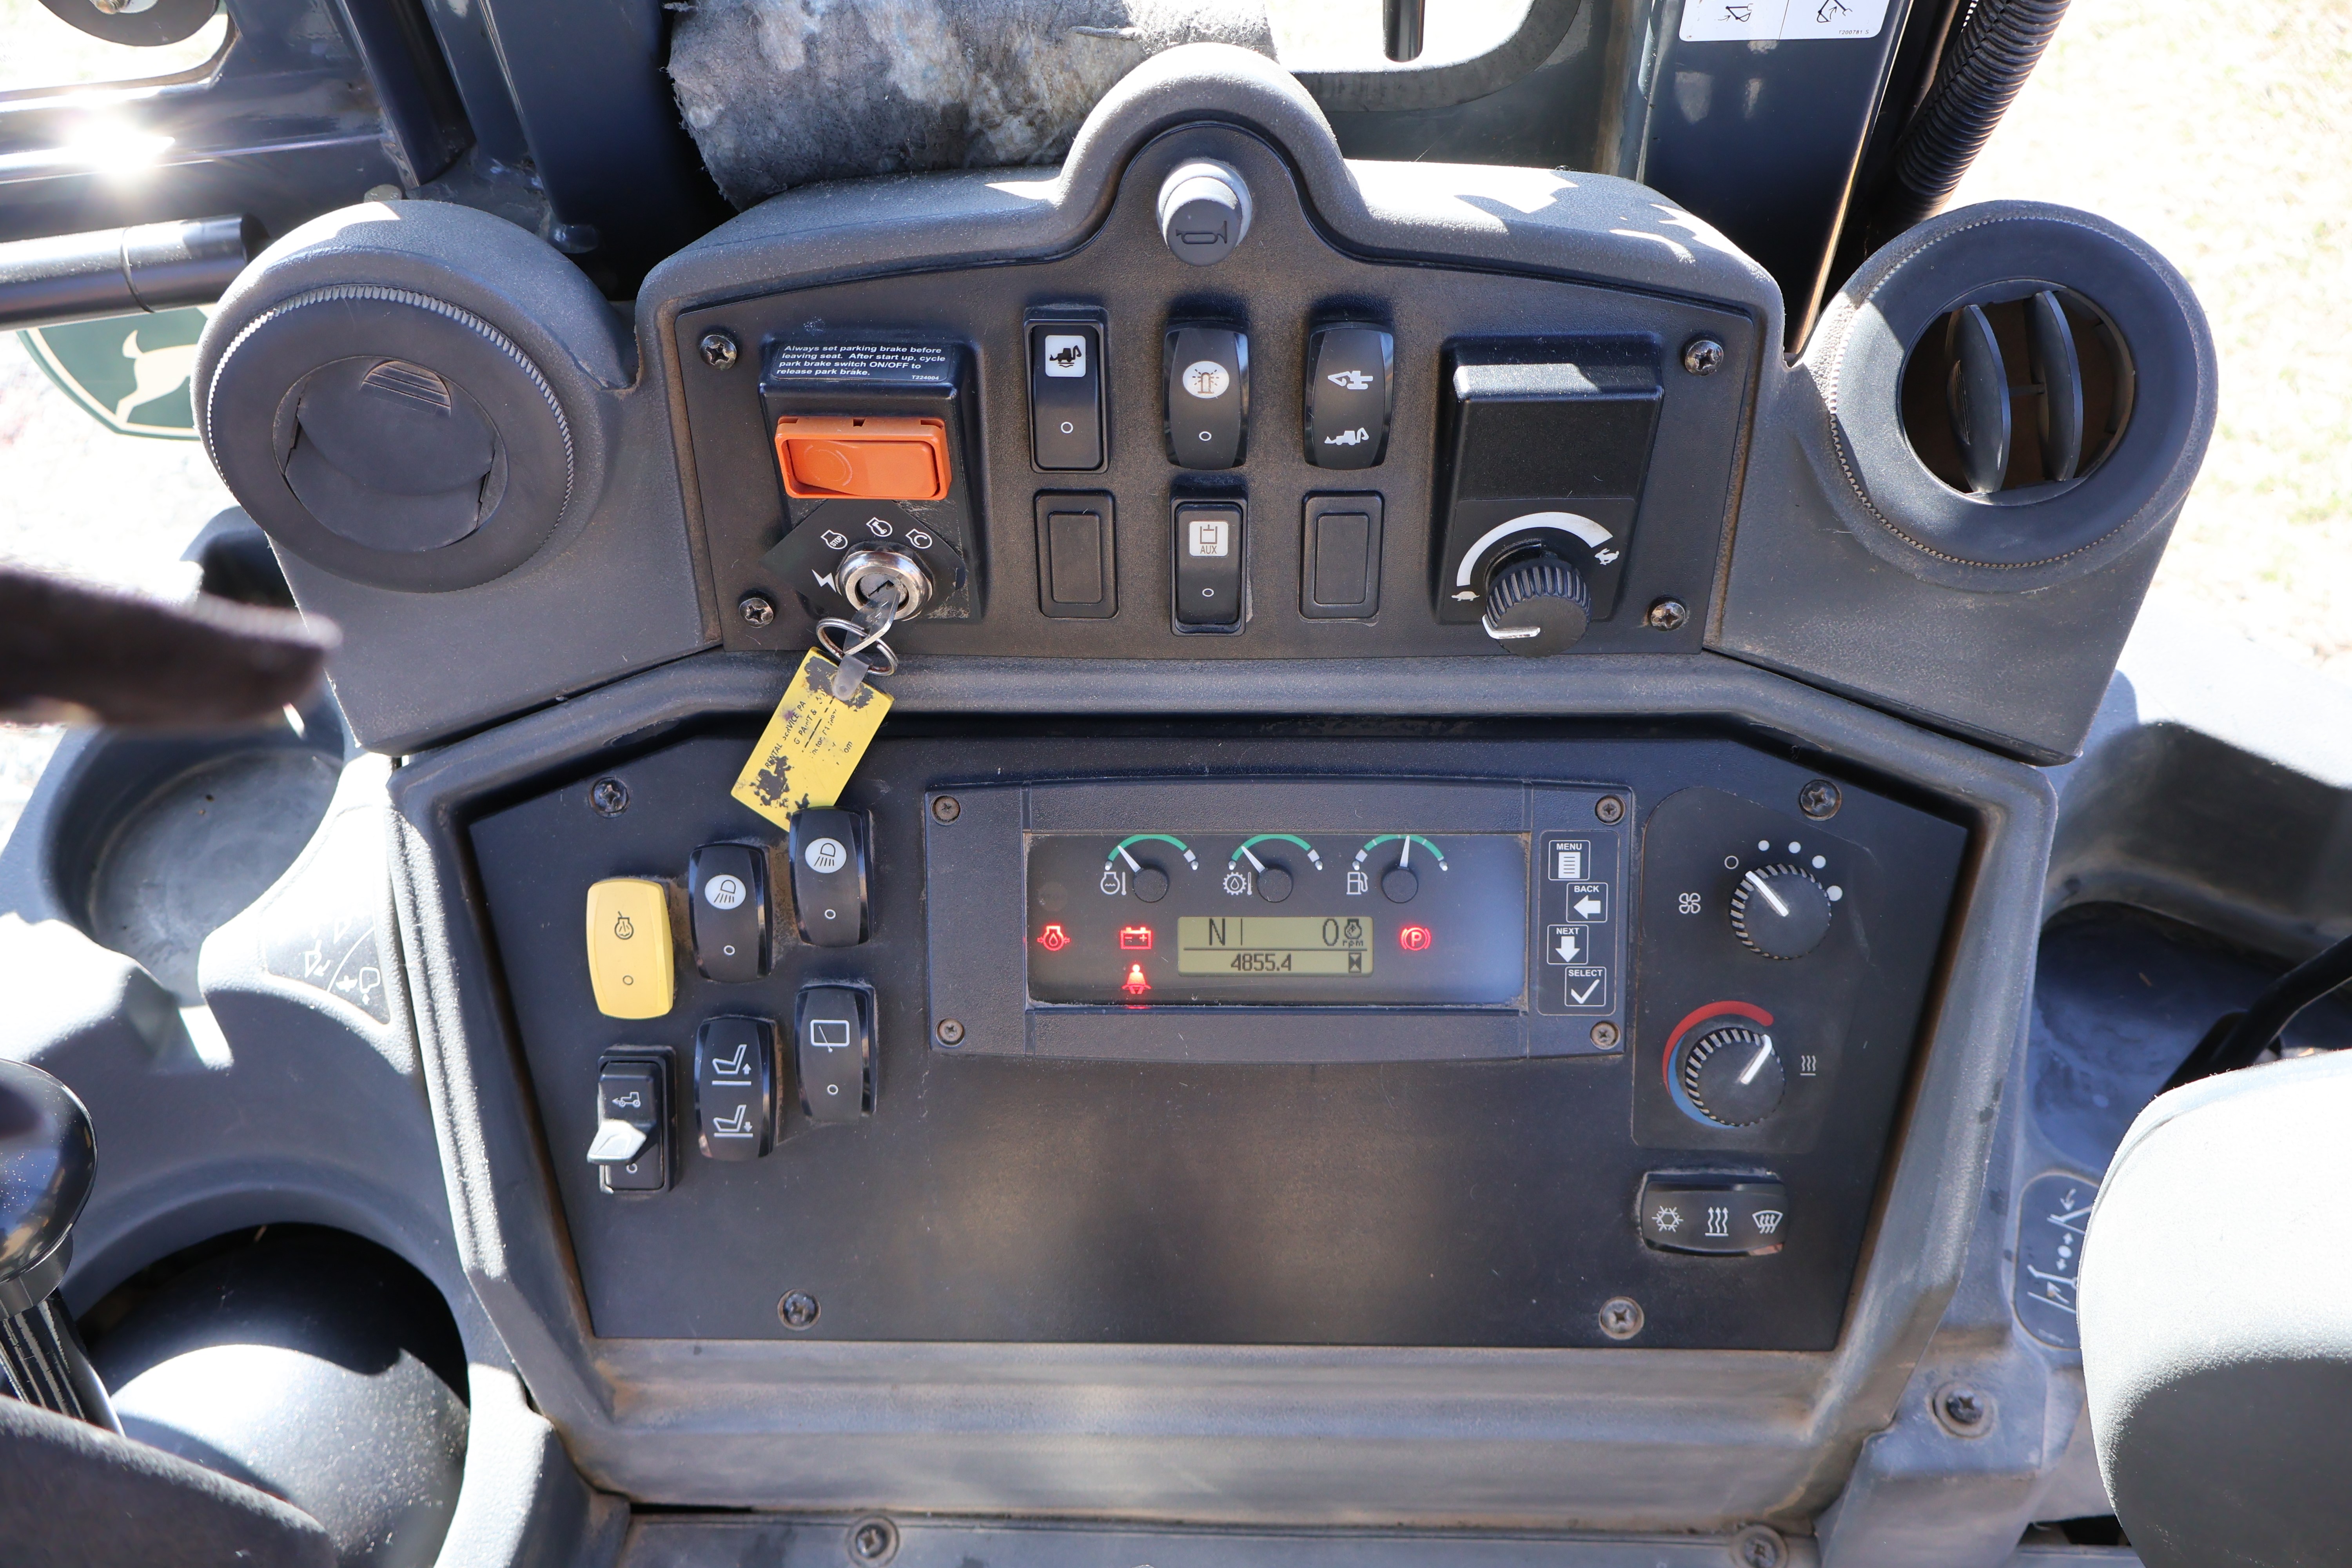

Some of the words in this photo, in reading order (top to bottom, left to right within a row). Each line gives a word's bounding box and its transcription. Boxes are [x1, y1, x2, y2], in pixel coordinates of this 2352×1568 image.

[829, 535, 843, 547] STOP
[1200, 545, 1217, 554] AUX
[764, 743, 783, 769] RENTAL
[1209, 918, 1226, 946] N
[1322, 918, 1339, 946] 0
[1343, 940, 1364, 948] rpm
[1230, 953, 1292, 971] 4855.4
